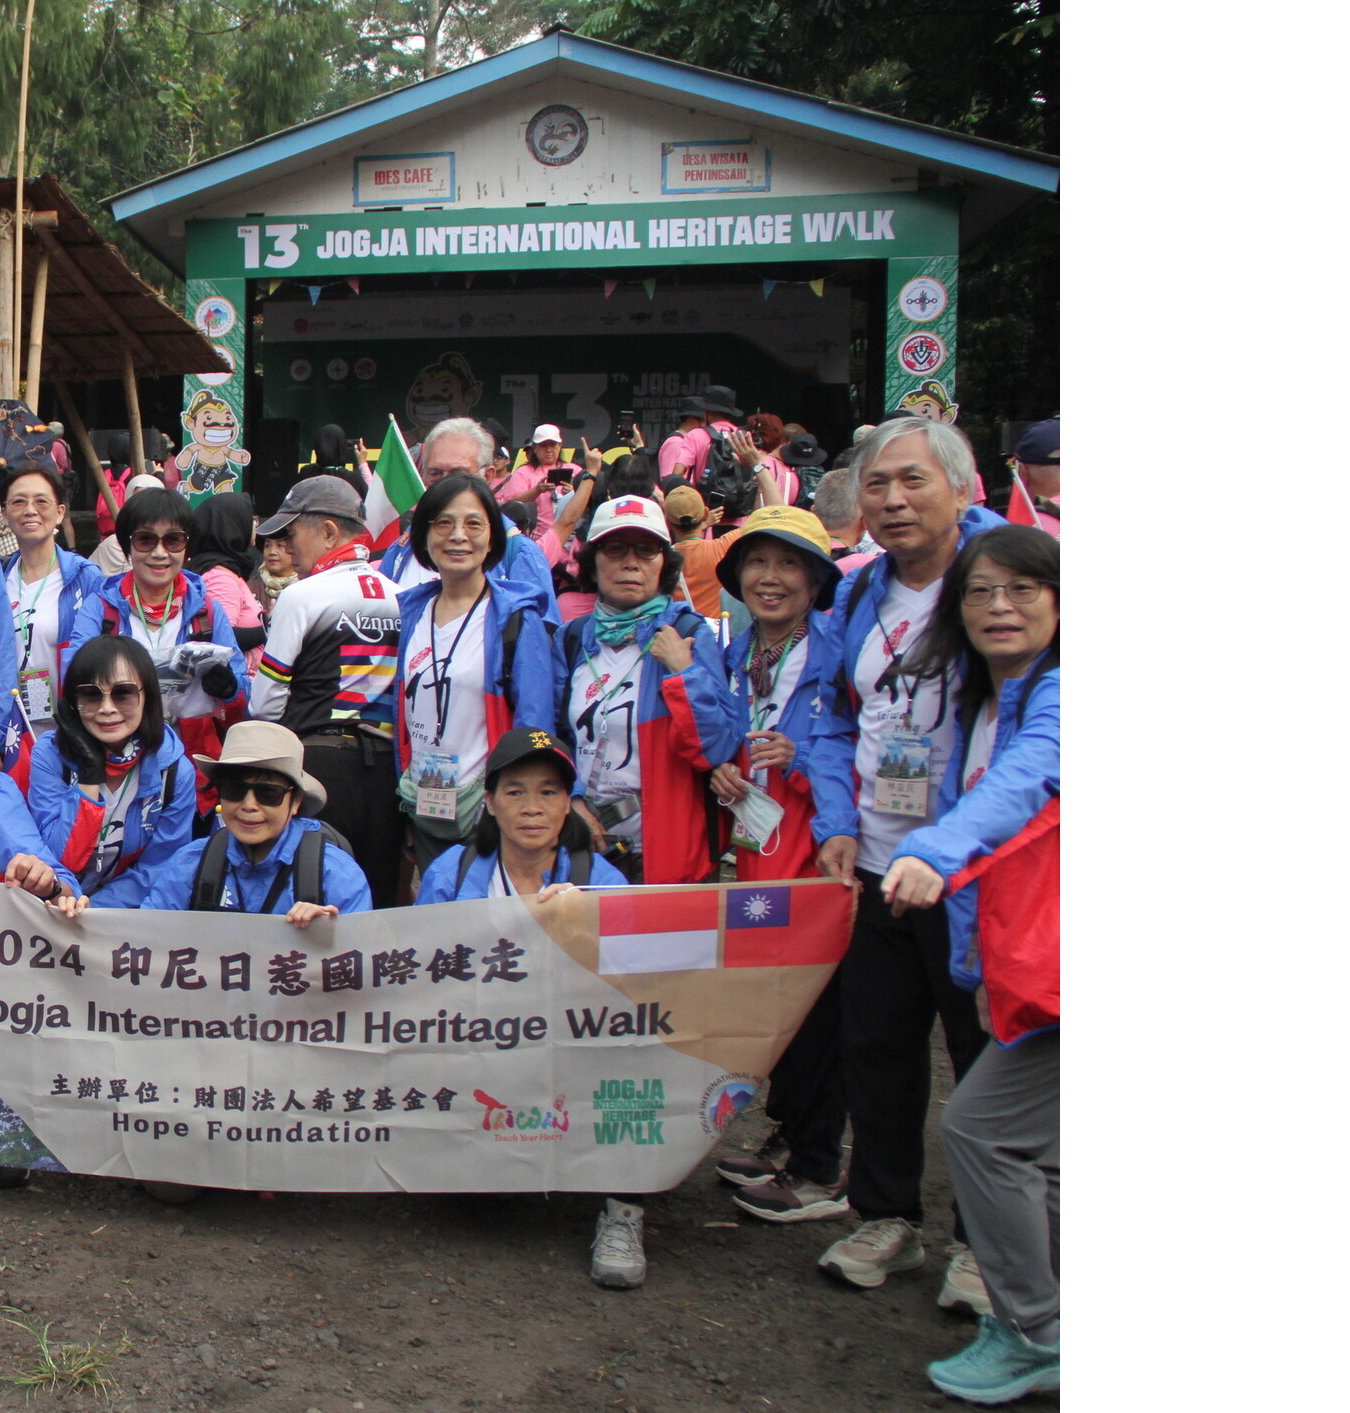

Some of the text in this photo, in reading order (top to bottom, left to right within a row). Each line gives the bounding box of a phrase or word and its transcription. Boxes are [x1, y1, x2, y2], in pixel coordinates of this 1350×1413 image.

[682, 151, 749, 166] DESA WISATA
[374, 167, 433, 186] IDES CAFE
[684, 168, 747, 181] PENTINGSARI
[237, 223, 300, 269] 13
[316, 227, 409, 259] JOGJA
[415, 220, 641, 256] INTERNATIONAL
[648, 213, 792, 249] HERITAGE
[801, 209, 896, 243] WALK
[633, 372, 711, 397] JOGJA
[111, 937, 529, 997] 印尼日惹國際健走
[87, 1001, 347, 1043] International
[364, 1009, 548, 1050] Heritage
[565, 1002, 675, 1039] Walk
[593, 1078, 665, 1101] JOGJA
[593, 1100, 665, 1110] INTERNATIONAL
[602, 1110, 657, 1122] HERITAGE
[112, 1112, 391, 1143] Hope Foundation
[494, 1133, 563, 1143] Touch Your Heart
[593, 1121, 665, 1145] WALK
